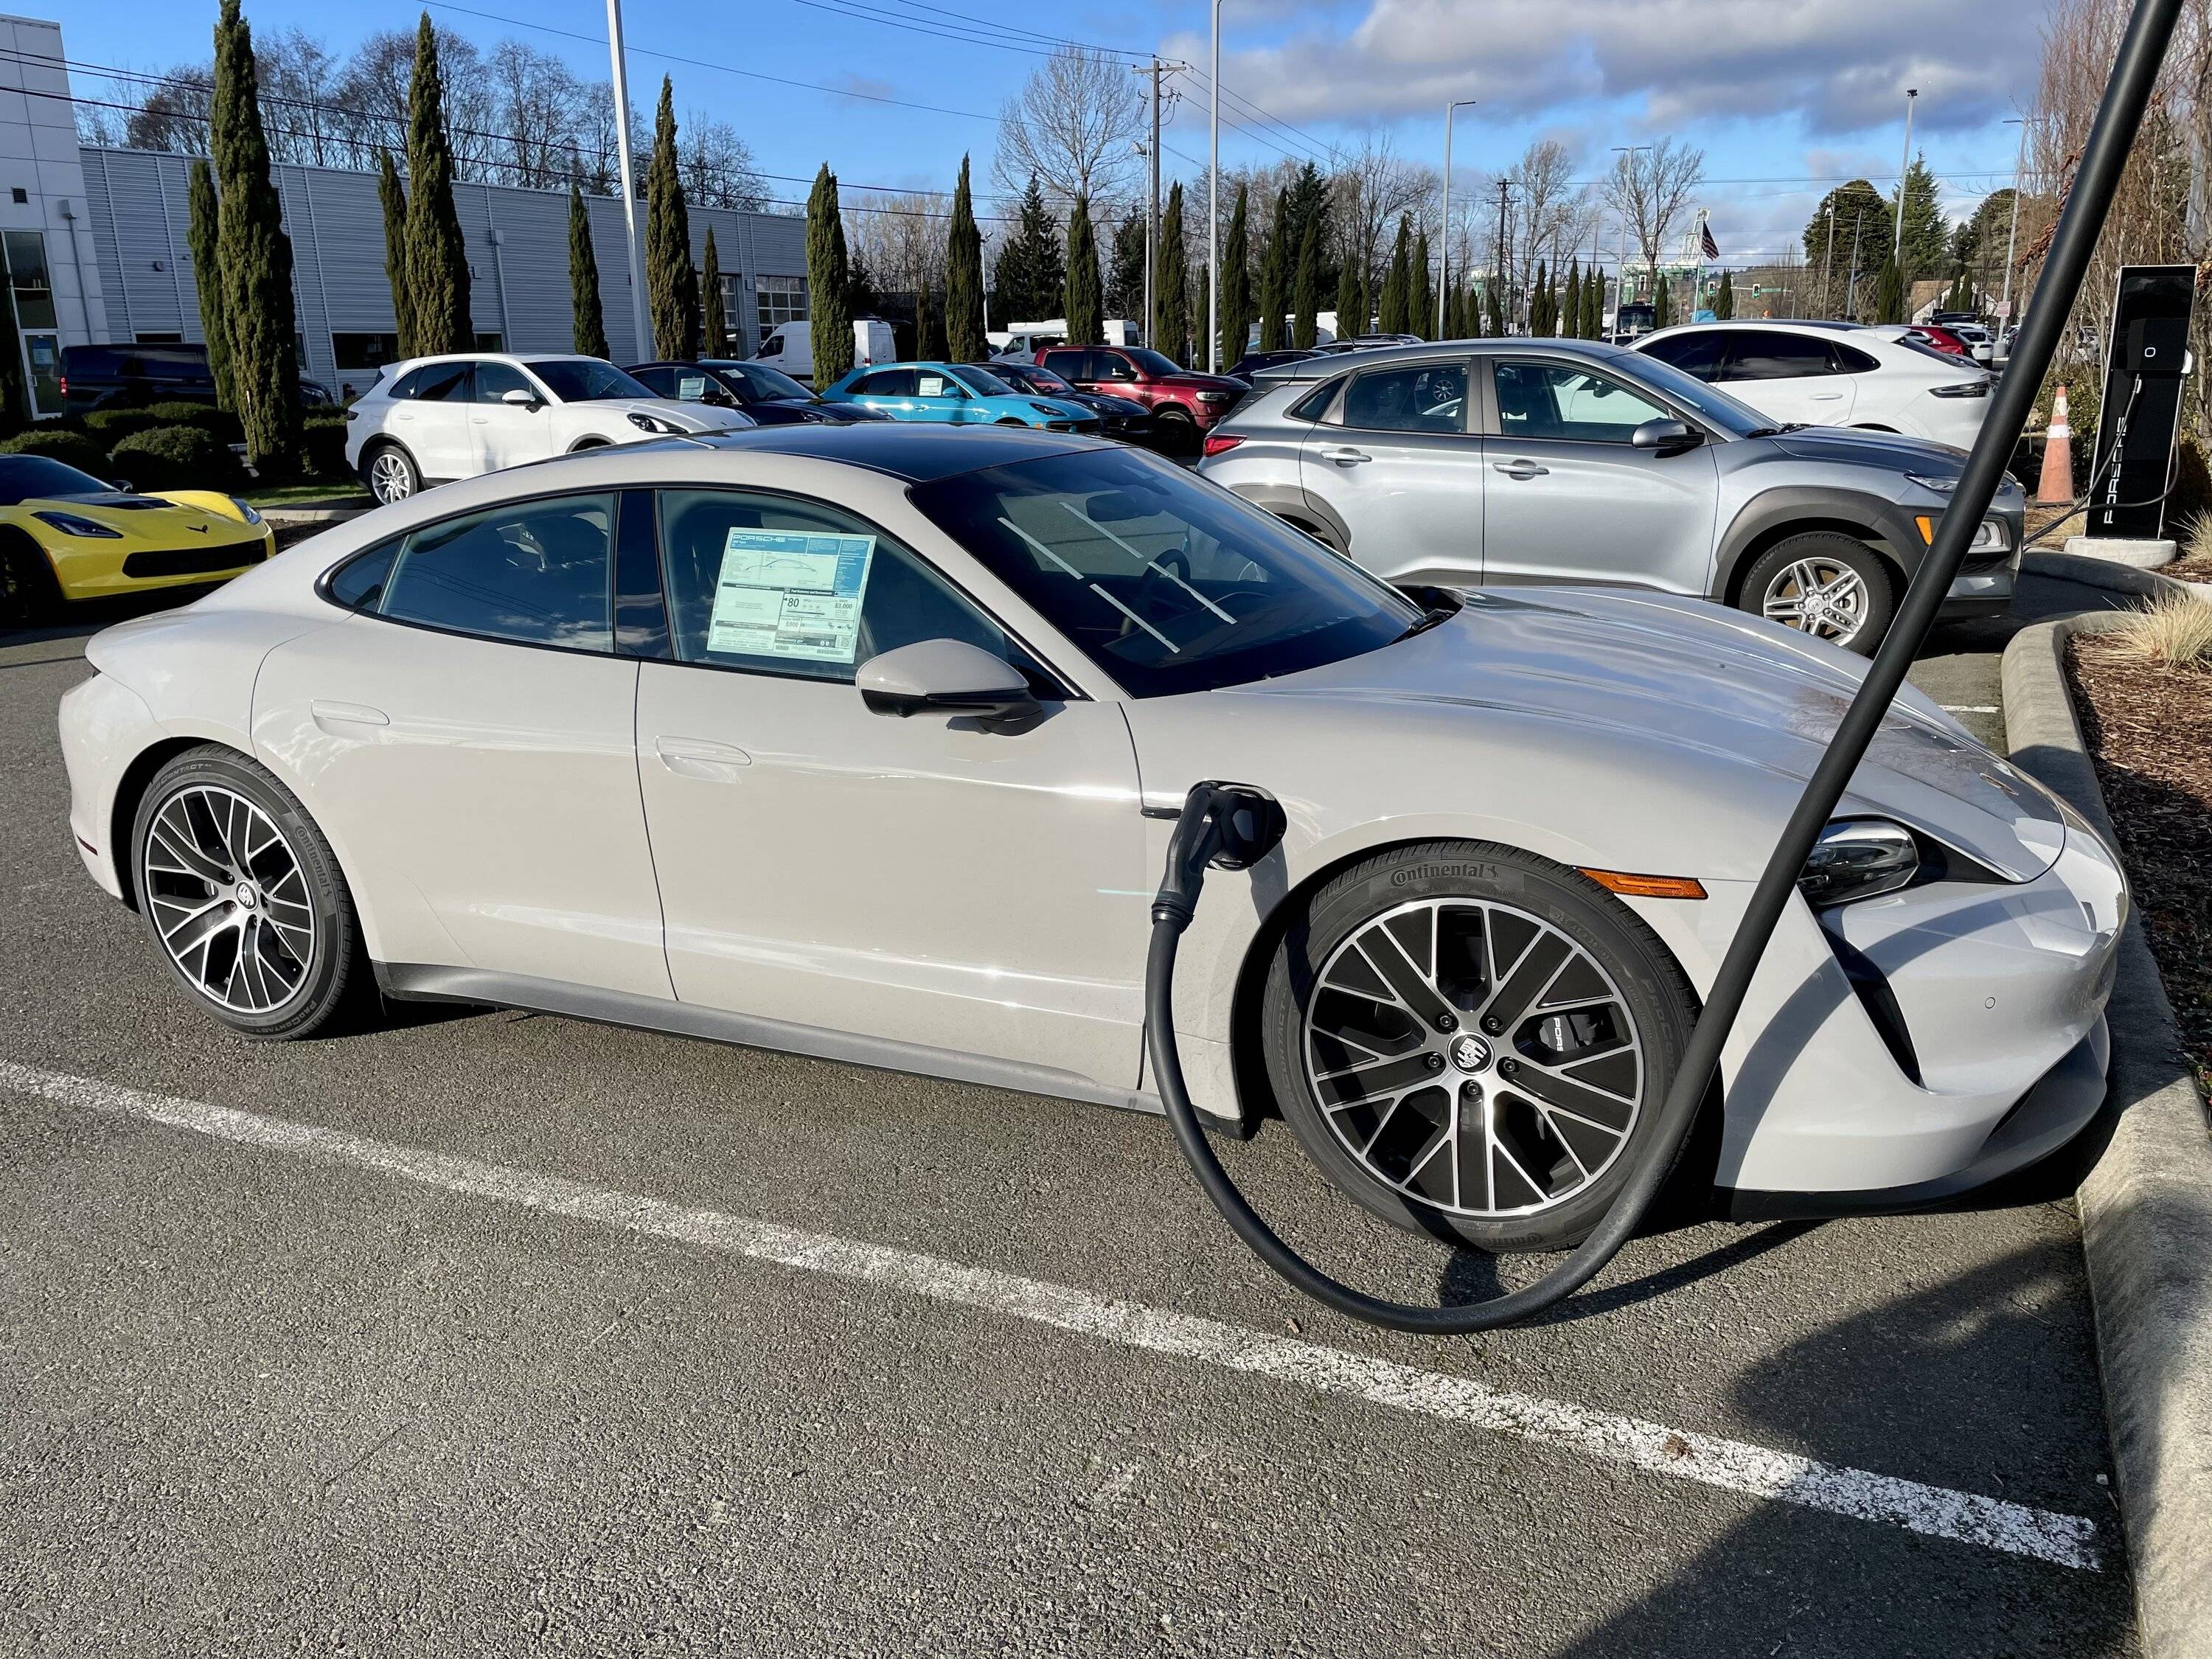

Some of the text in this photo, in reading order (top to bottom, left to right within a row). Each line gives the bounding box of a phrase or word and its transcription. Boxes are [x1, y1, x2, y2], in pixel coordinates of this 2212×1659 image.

[733, 534, 786, 543] PORSCHE
[787, 597, 799, 608] 80
[296, 826, 330, 888] Continental
[1391, 863, 1484, 887] Continental
[1554, 1017, 1564, 1051] PORS
